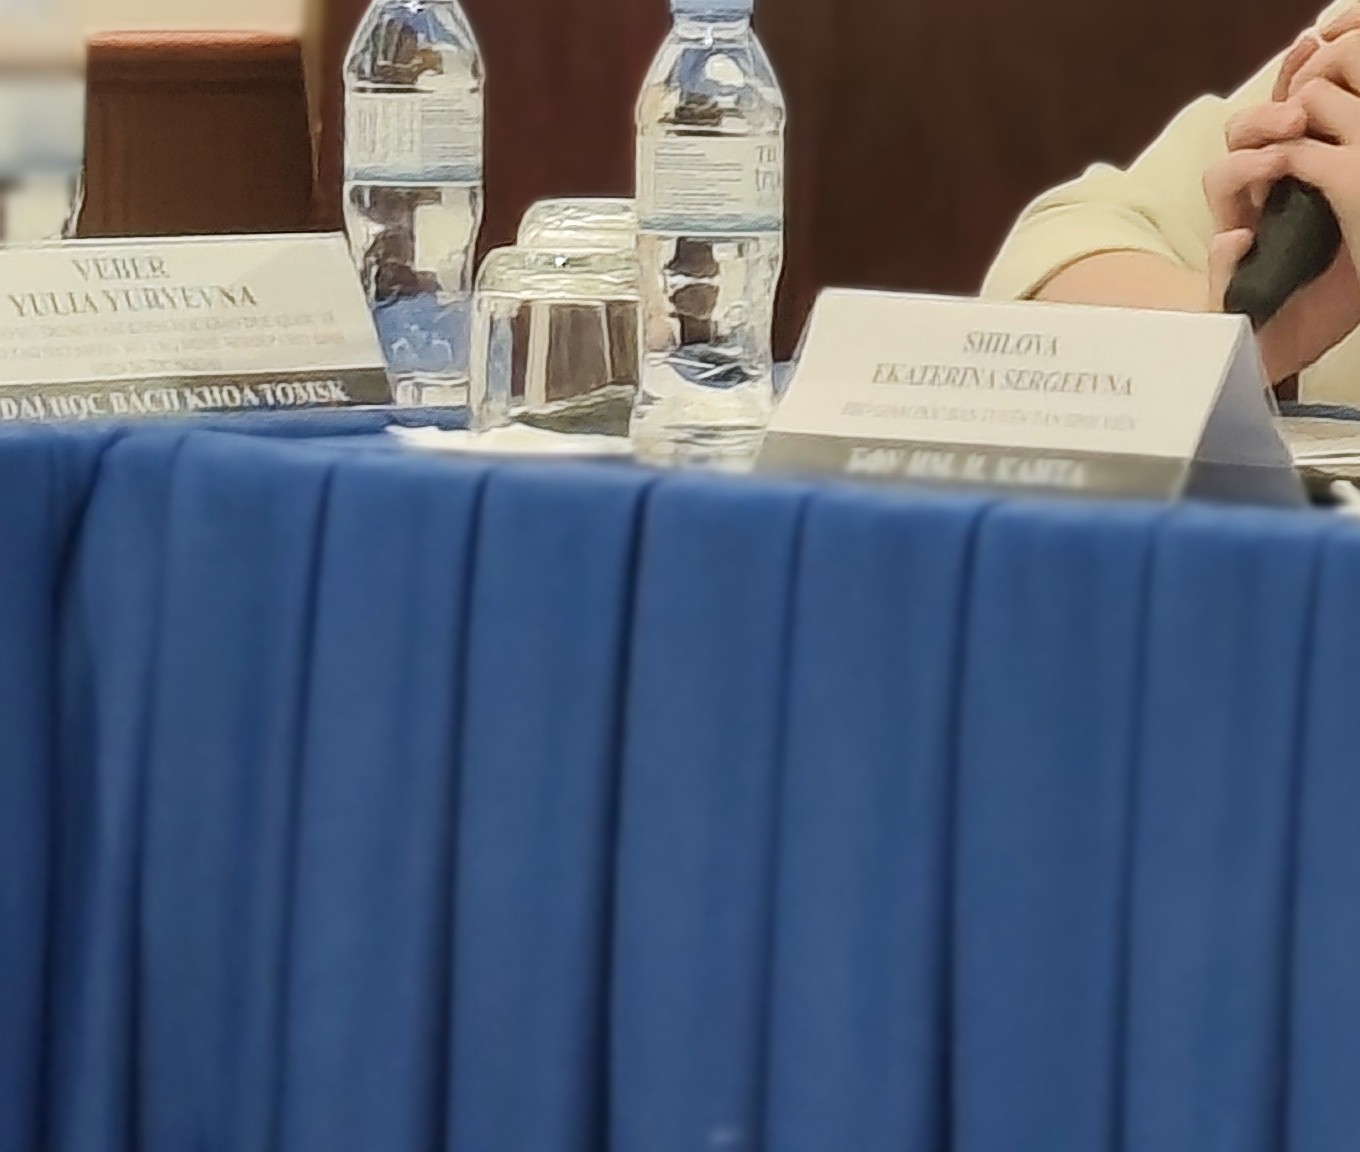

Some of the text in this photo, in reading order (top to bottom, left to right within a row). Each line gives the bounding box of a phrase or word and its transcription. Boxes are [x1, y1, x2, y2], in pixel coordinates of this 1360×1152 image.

[73, 256, 171, 282] VEBER
[8, 285, 258, 318] YULIA YURYEVNA
[963, 331, 1060, 356] SHILOVA
[872, 363, 1133, 396] EKATERINA SERGEEVNA
[183, 384, 259, 410] KHOA
